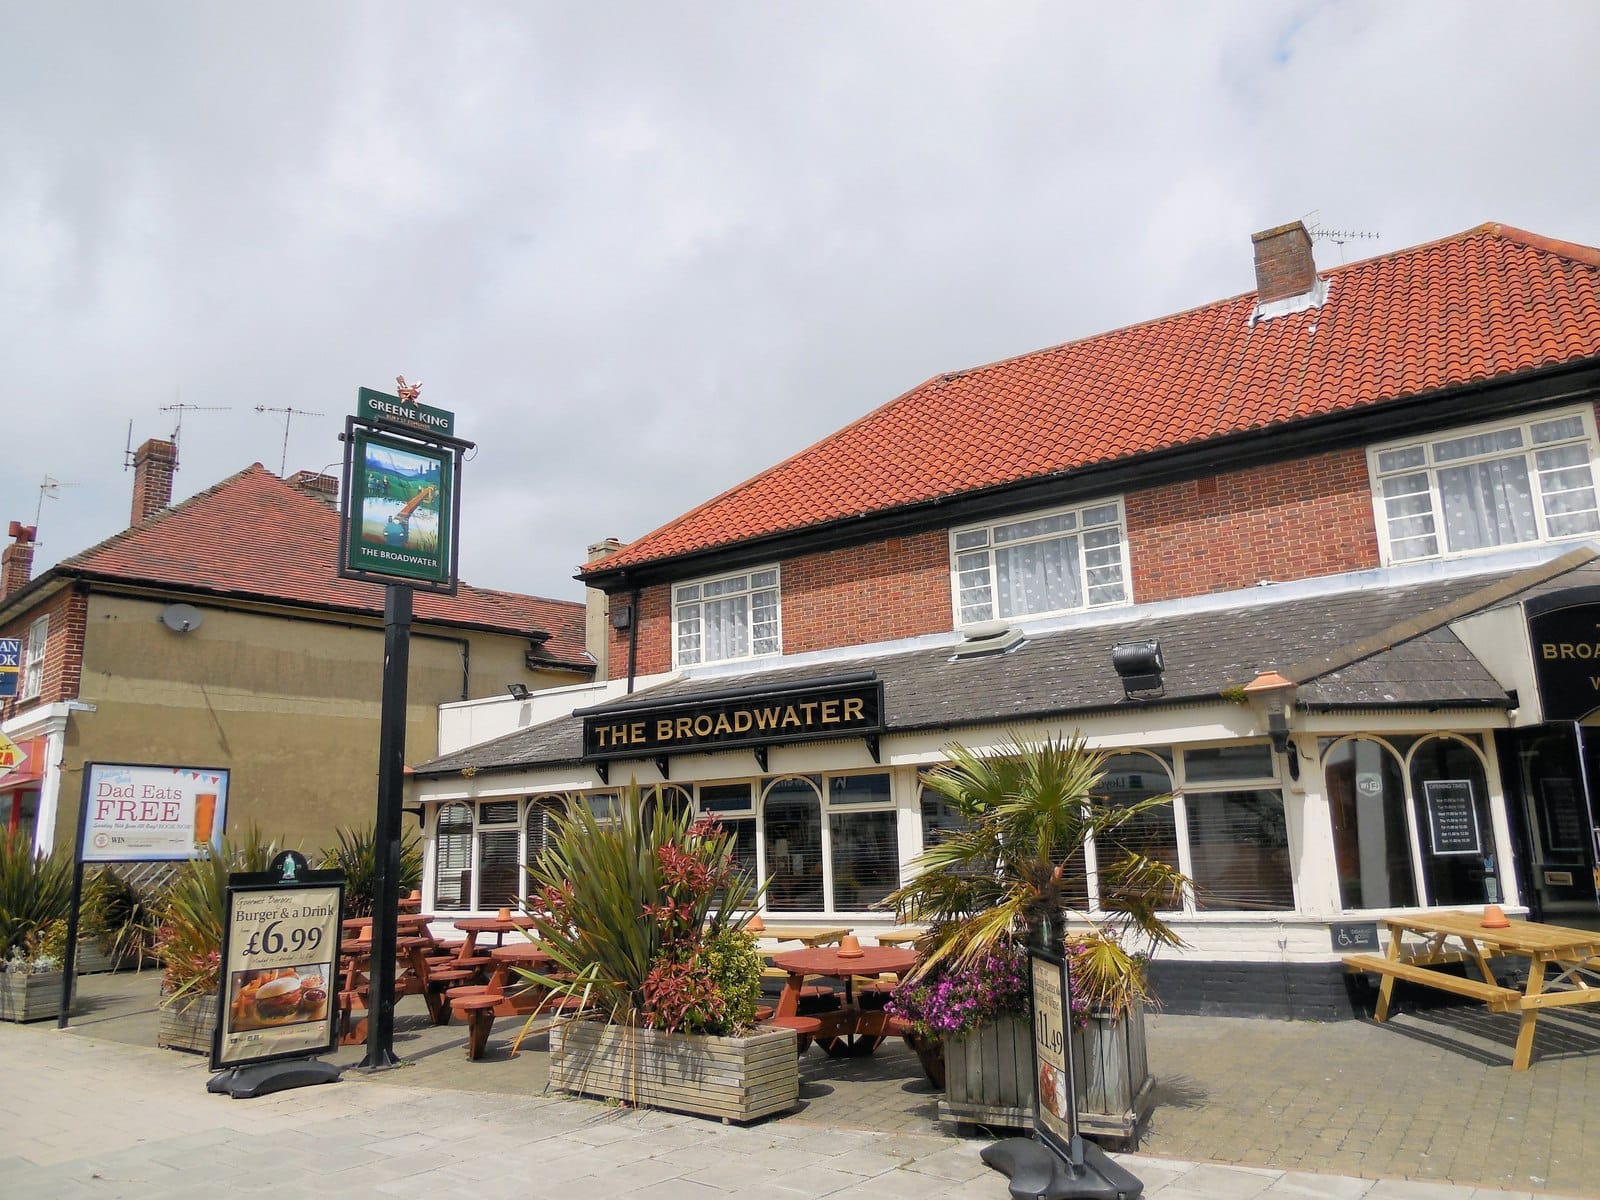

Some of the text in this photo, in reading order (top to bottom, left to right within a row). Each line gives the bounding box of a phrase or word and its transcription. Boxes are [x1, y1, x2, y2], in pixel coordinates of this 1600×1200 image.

[368, 399, 416, 420] GREENE
[419, 413, 449, 428] KING
[361, 547, 438, 567] THE BROADWATER
[595, 698, 865, 747] THE BROADWATER
[97, 782, 182, 799] Dad Eats
[94, 799, 181, 822] FREE
[236, 904, 334, 923] Burger & a Drink
[242, 920, 323, 956] £6.99
